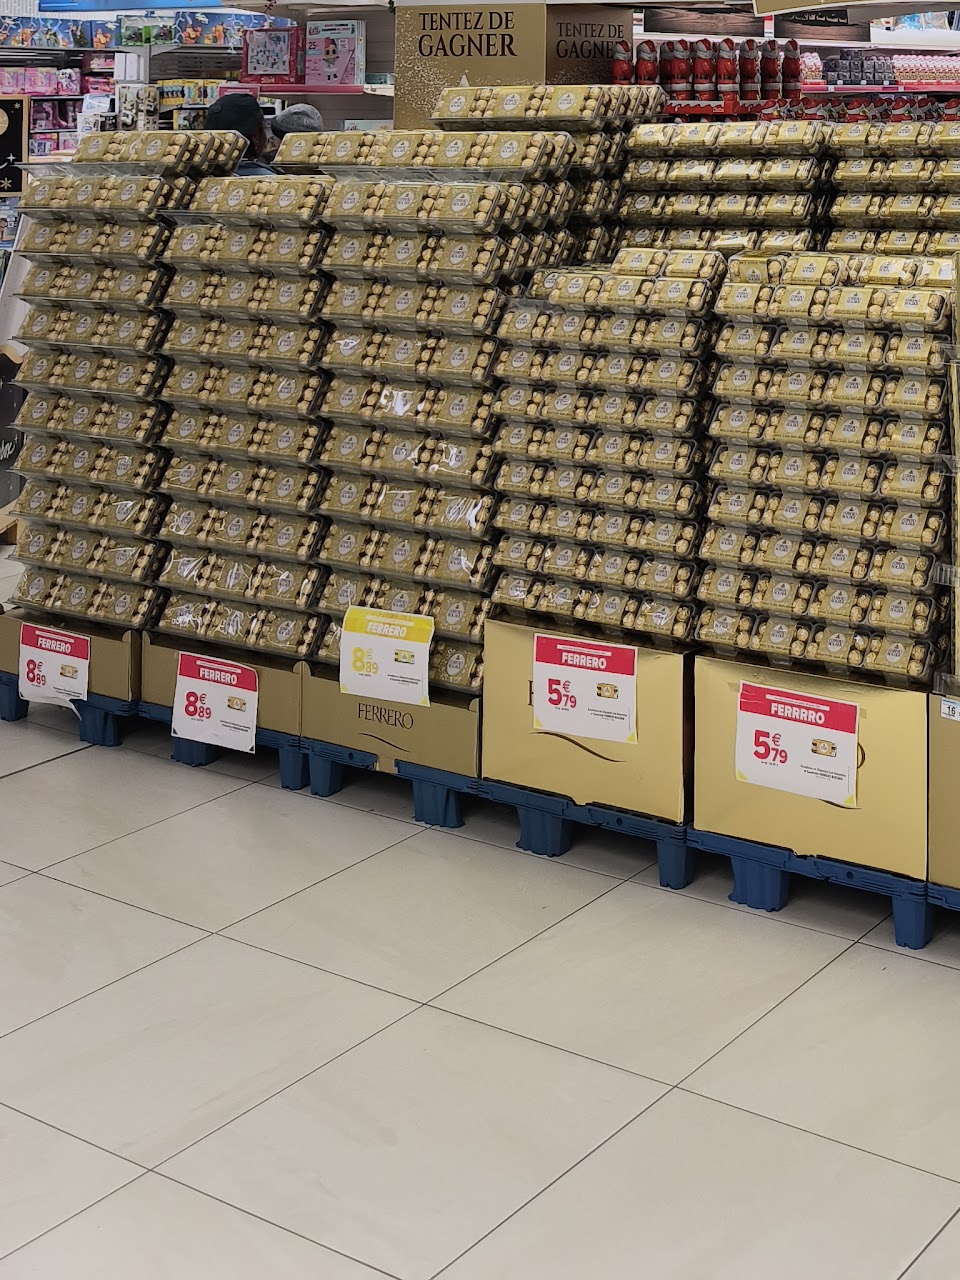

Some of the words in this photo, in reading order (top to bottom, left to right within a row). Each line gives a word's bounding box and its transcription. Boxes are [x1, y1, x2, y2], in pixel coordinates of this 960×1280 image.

[419, 12, 484, 31] TENTEZ
[489, 11, 515, 30] DE
[556, 22, 605, 38] TENTEZ
[608, 24, 624, 38] DE
[418, 33, 517, 57] GAGNER
[366, 621, 407, 638] FERRERO
[37, 637, 72, 654] FERRERO
[561, 651, 607, 670] FERRERO
[199, 667, 238, 685] FERRERO
[357, 701, 414, 730] FERRERO
